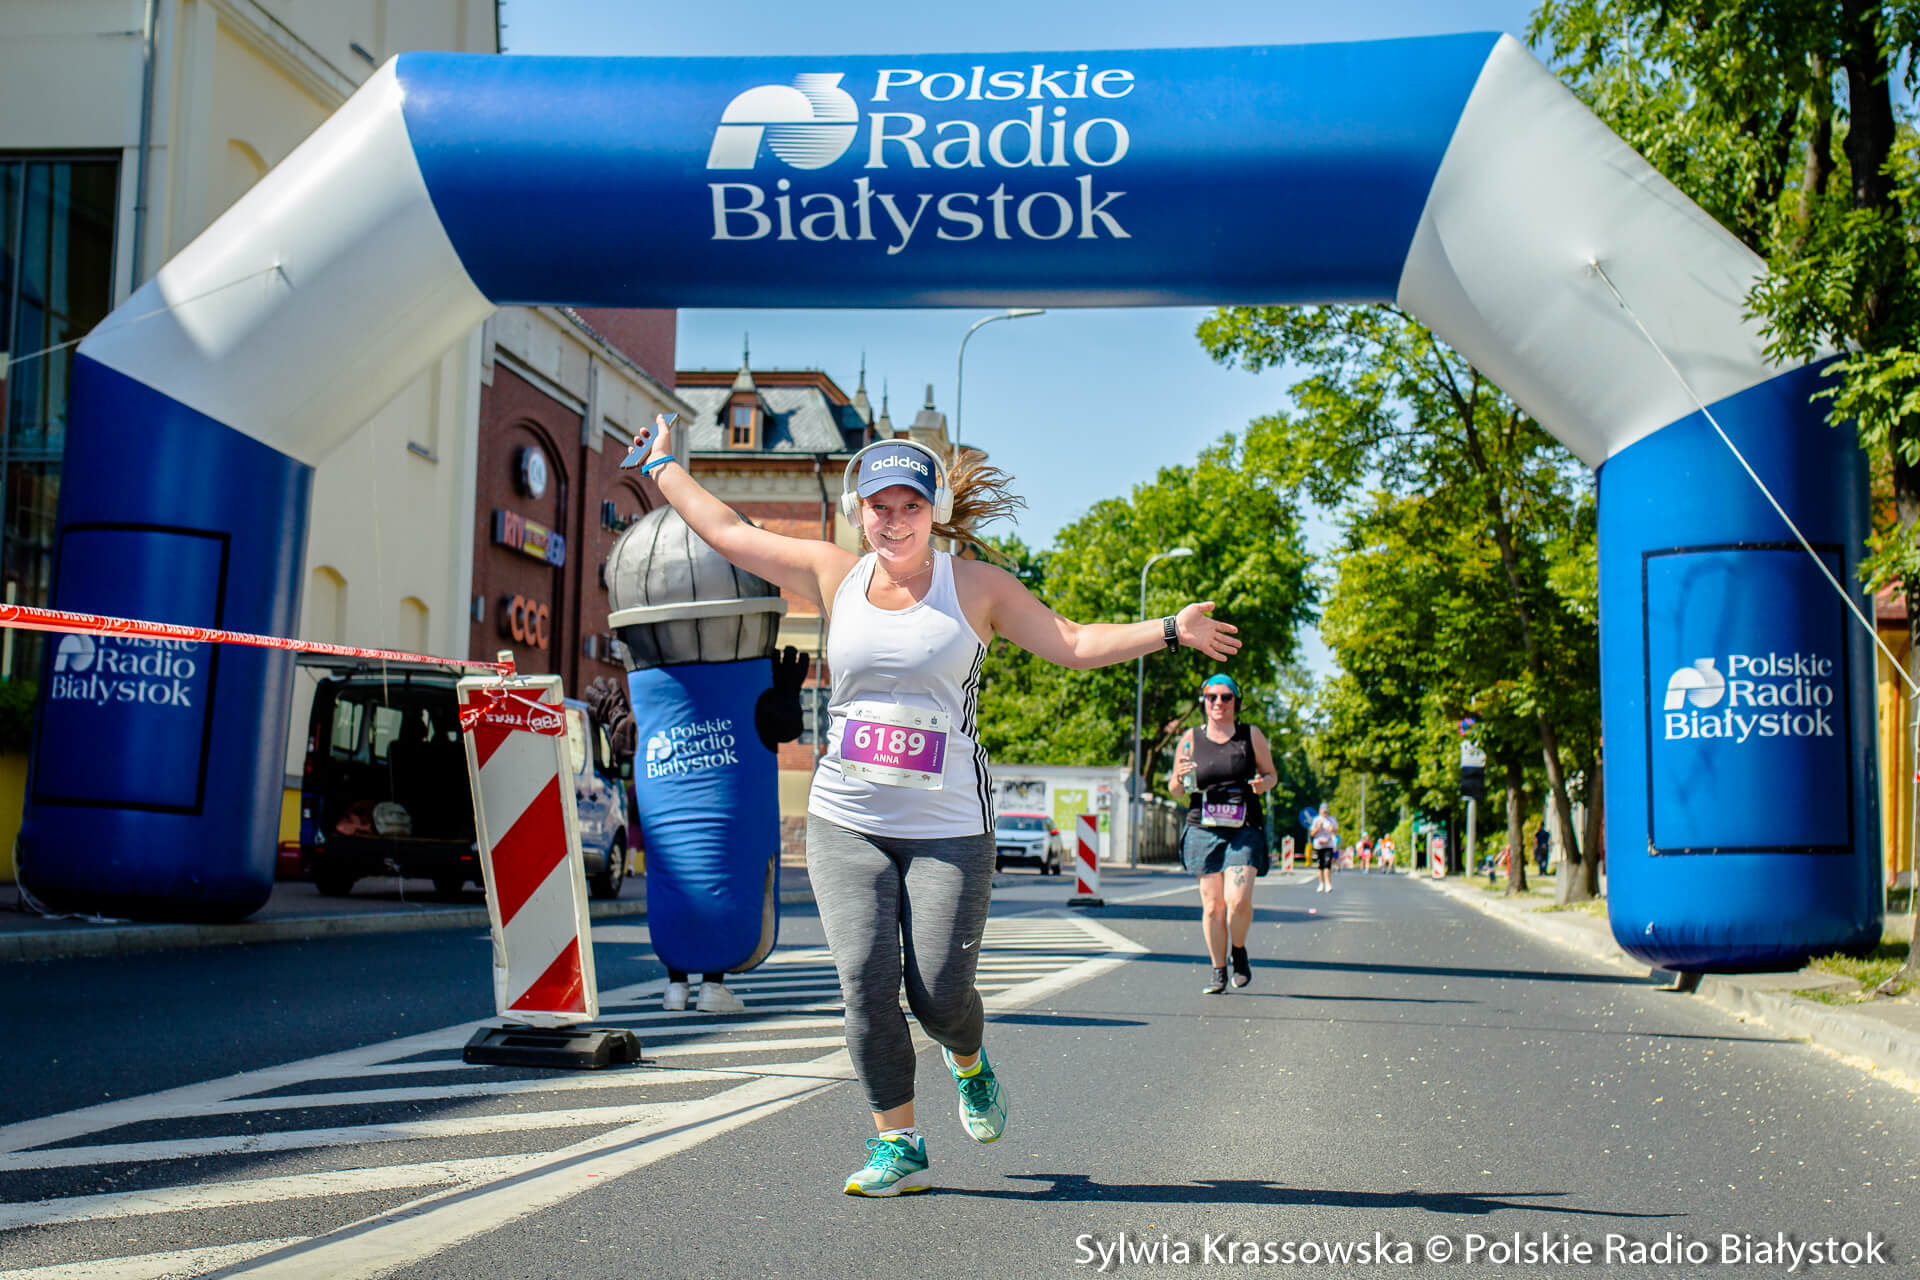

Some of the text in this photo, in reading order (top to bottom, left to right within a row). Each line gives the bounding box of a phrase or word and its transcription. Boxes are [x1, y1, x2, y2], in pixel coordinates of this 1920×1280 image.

[870, 64, 1134, 101] Polskie
[864, 105, 1130, 169] Radio
[707, 174, 1131, 255] Białystok
[871, 456, 928, 476] adidas
[511, 595, 549, 649] CCC
[97, 648, 196, 679] Radio
[1728, 652, 1832, 677] Polskie
[1728, 678, 1833, 707] Radio
[671, 718, 732, 740] Polskie
[854, 725, 926, 756] 6189
[1664, 708, 1834, 744] Białystok
[672, 733, 735, 757] Radio
[873, 753, 899, 765] ANNA
